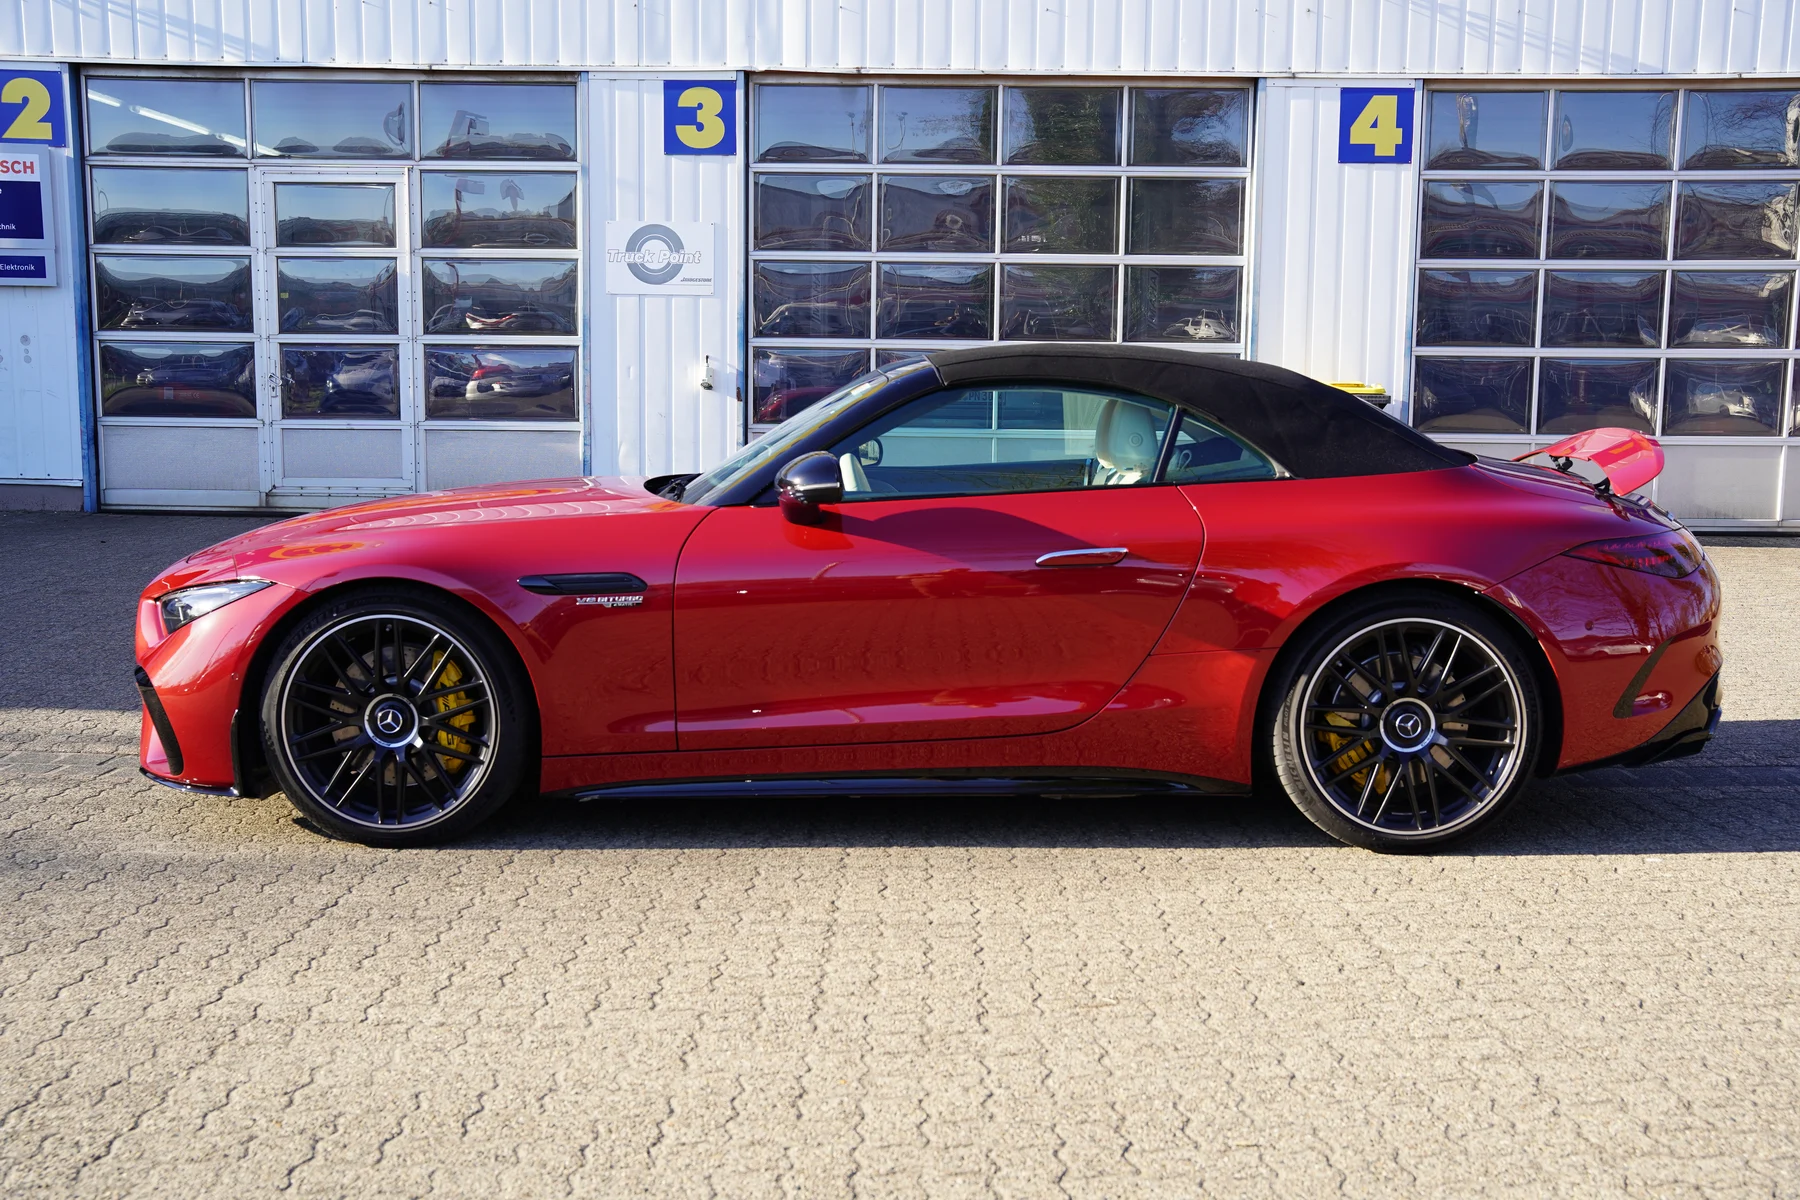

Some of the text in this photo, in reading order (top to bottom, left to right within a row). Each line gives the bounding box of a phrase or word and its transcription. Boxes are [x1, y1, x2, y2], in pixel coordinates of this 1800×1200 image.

[1, 77, 53, 140] 2
[675, 86, 726, 149] 3
[1349, 94, 1403, 157] 4
[607, 249, 702, 264] Truck Point
